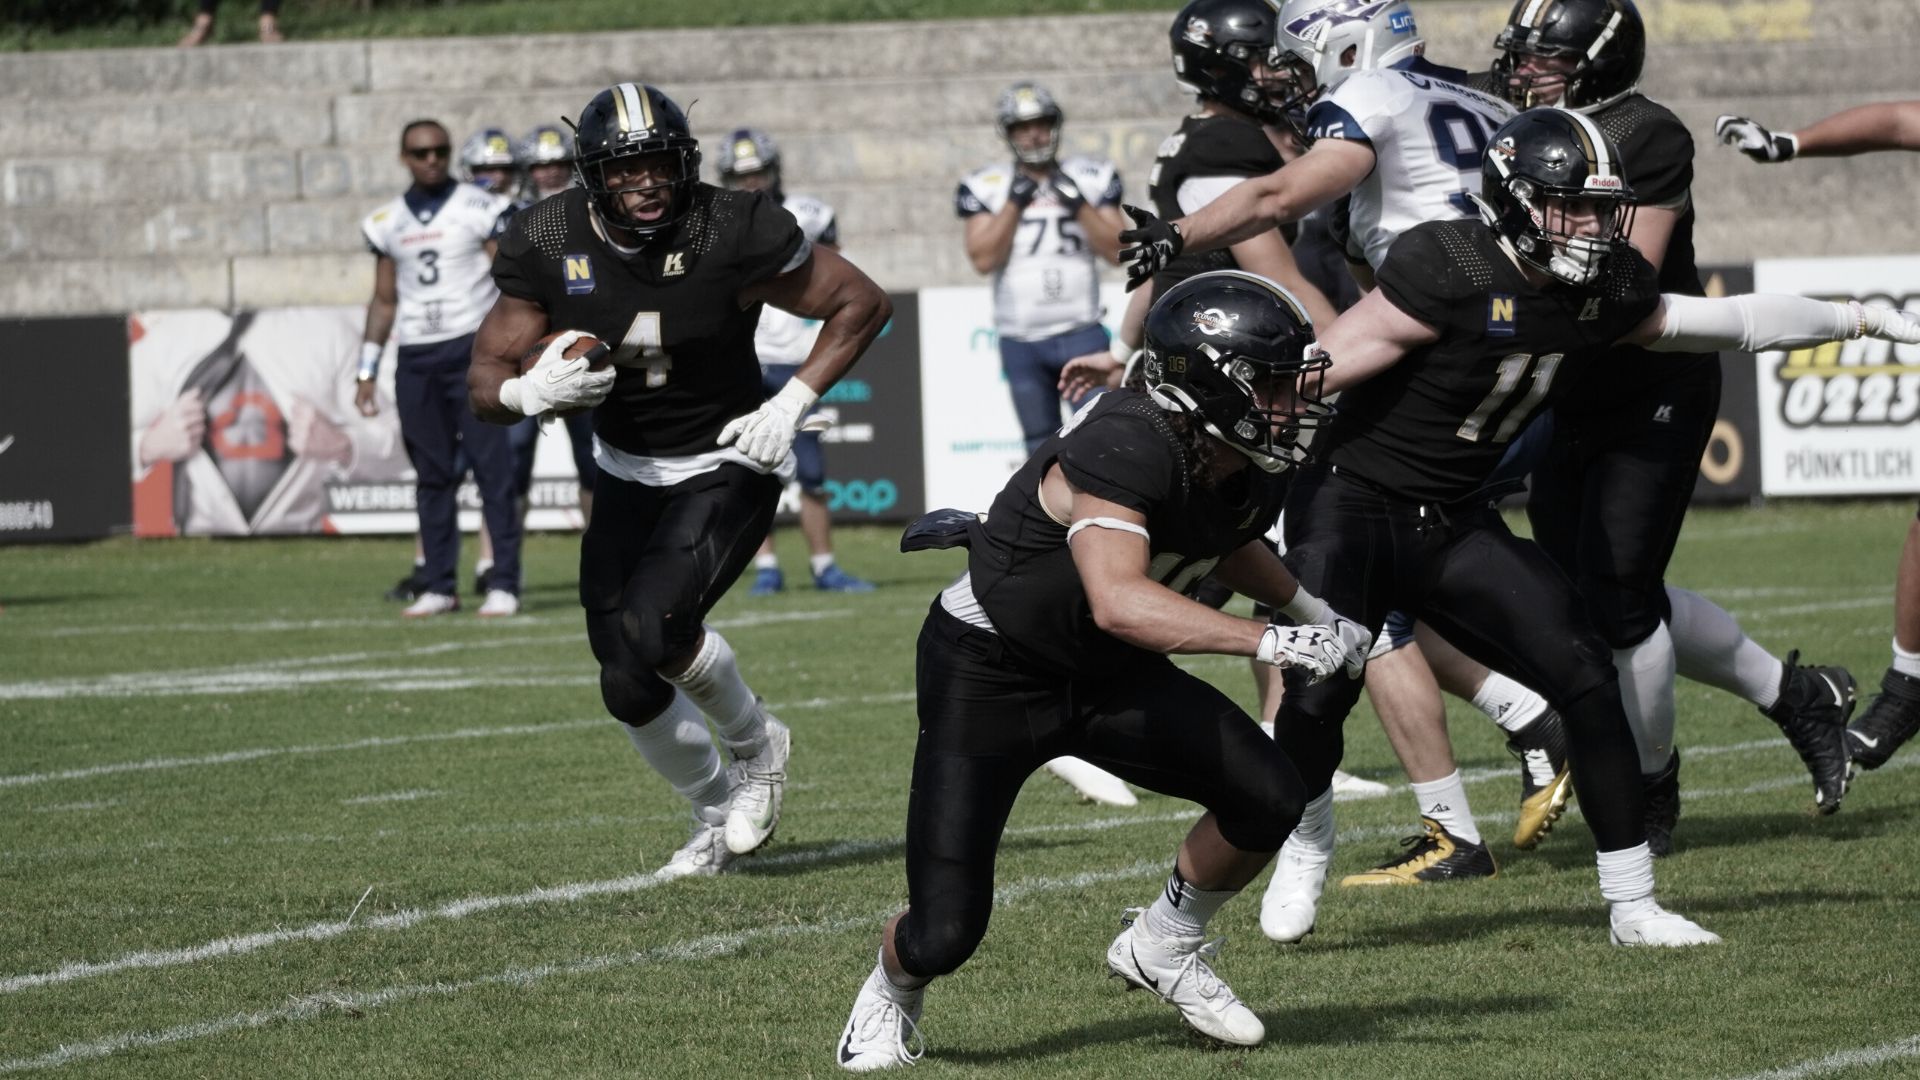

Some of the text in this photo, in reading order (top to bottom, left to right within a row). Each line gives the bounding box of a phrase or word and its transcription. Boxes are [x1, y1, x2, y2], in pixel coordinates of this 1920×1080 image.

[1021, 217, 1083, 254] 75
[418, 249, 440, 286] 3
[566, 259, 591, 281] N
[1492, 298, 1514, 321] N
[612, 311, 673, 388] 4
[1456, 352, 1564, 443] 11
[1786, 445, 1913, 481] PÜNKTLICH
